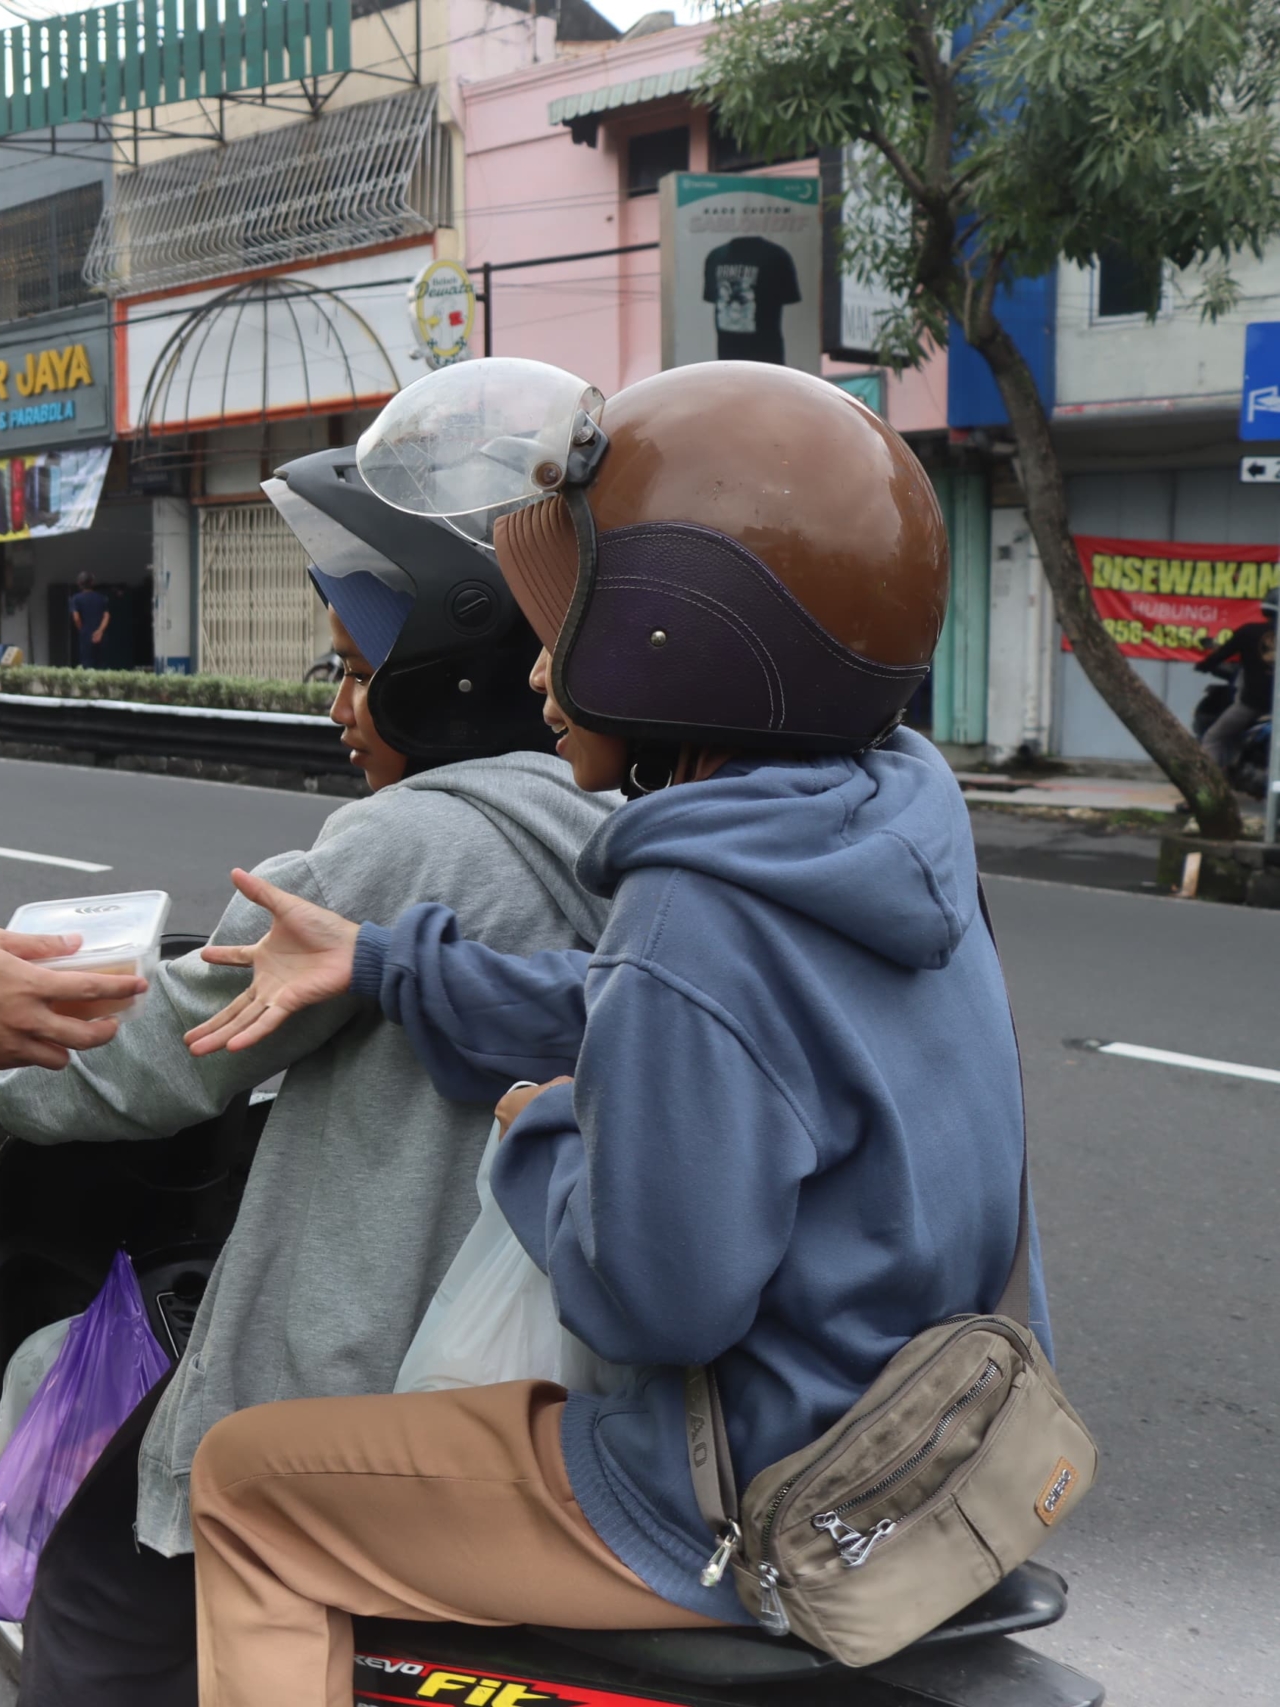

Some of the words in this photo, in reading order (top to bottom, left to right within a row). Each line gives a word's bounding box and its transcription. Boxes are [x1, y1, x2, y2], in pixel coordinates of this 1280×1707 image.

[15, 343, 92, 397] JAYA
[9, 400, 74, 427] PARABOLA
[1131, 602, 1218, 622] HUBUNGI
